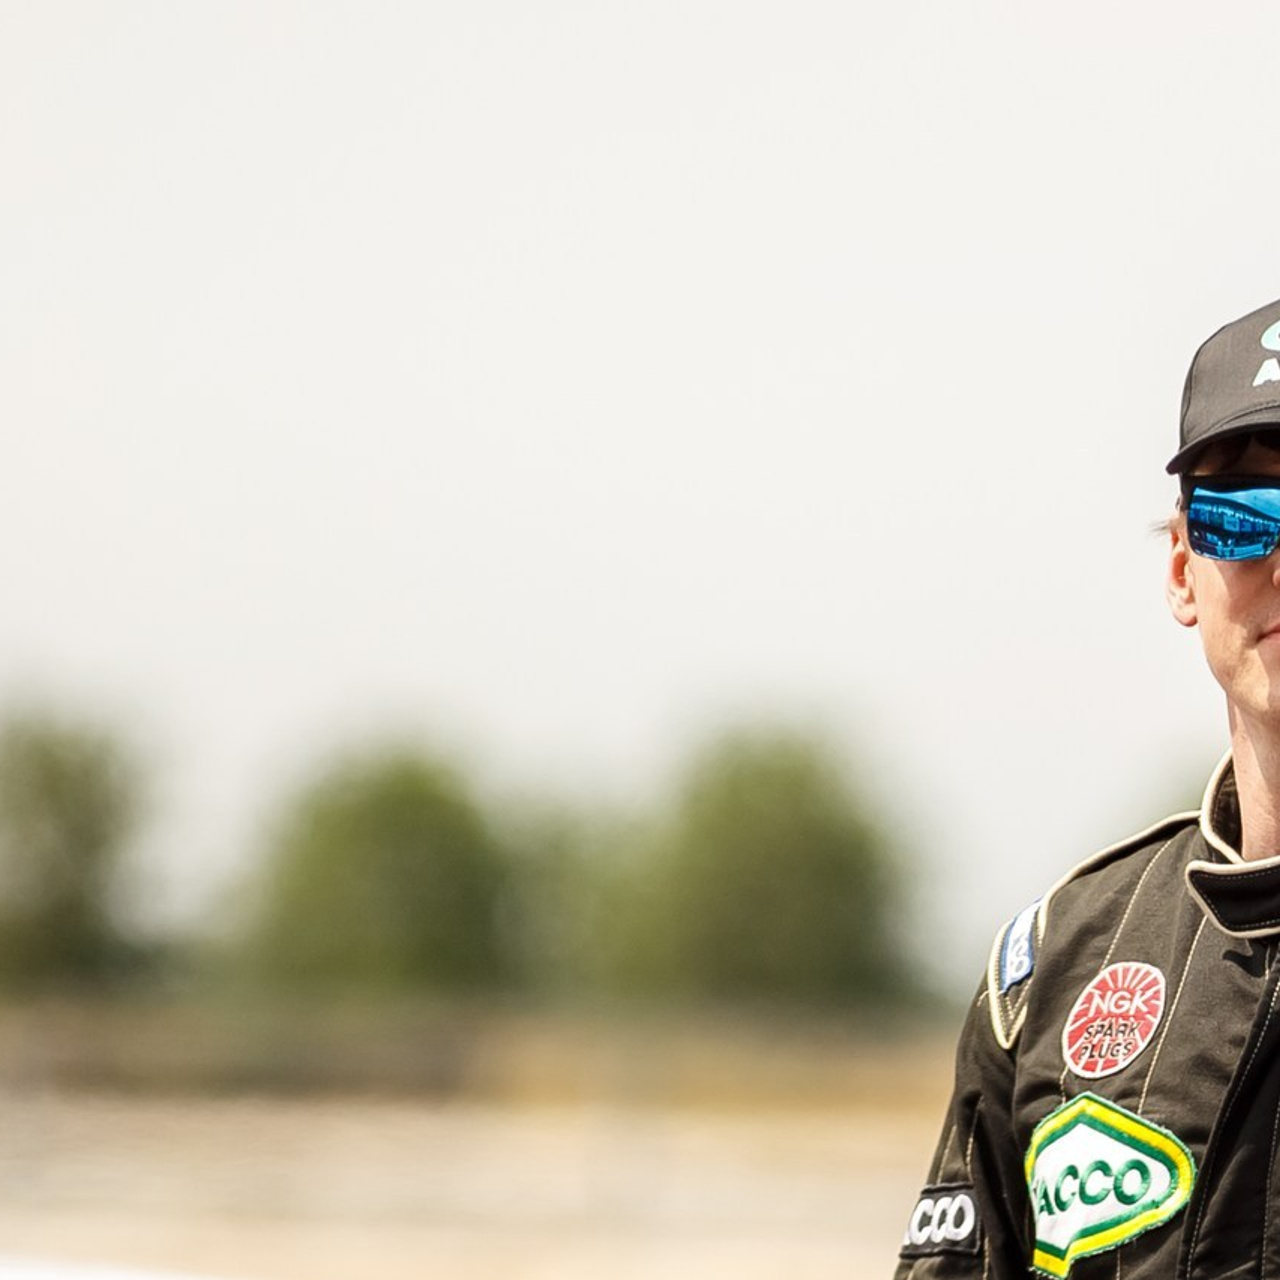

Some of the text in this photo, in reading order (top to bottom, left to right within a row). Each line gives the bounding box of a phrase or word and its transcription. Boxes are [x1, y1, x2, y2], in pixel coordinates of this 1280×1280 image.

[1087, 990, 1149, 1018] NGK
[1083, 1020, 1141, 1041] SPARK
[1077, 1041, 1133, 1060] PLUGS
[903, 1193, 975, 1246] CCO
